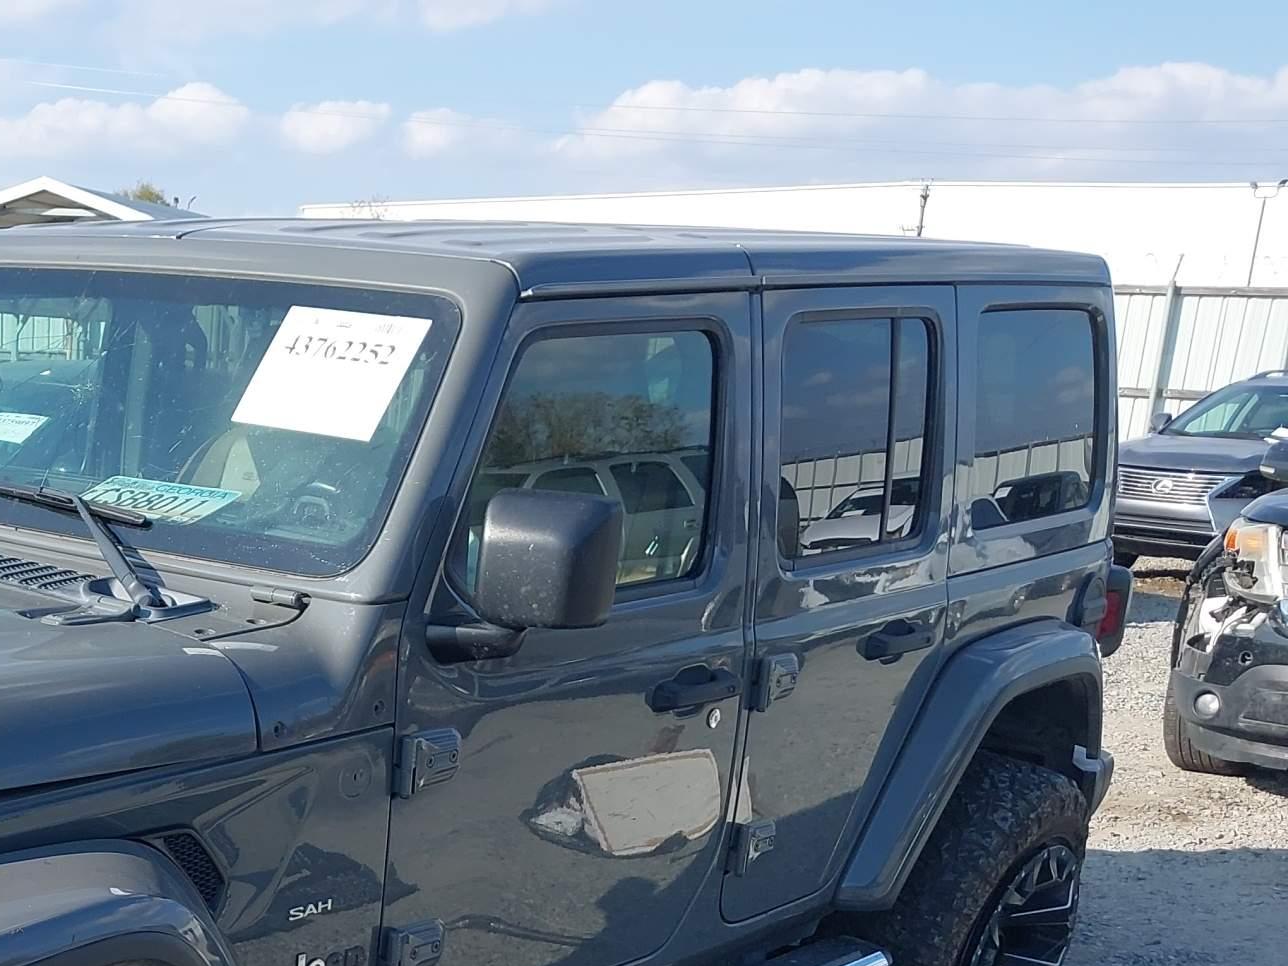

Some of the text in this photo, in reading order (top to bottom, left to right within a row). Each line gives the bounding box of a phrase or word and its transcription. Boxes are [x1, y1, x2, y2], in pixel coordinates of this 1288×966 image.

[285, 335, 396, 366] 43762252
[155, 484, 229, 500] GEORGIA
[288, 898, 333, 921] SAH
